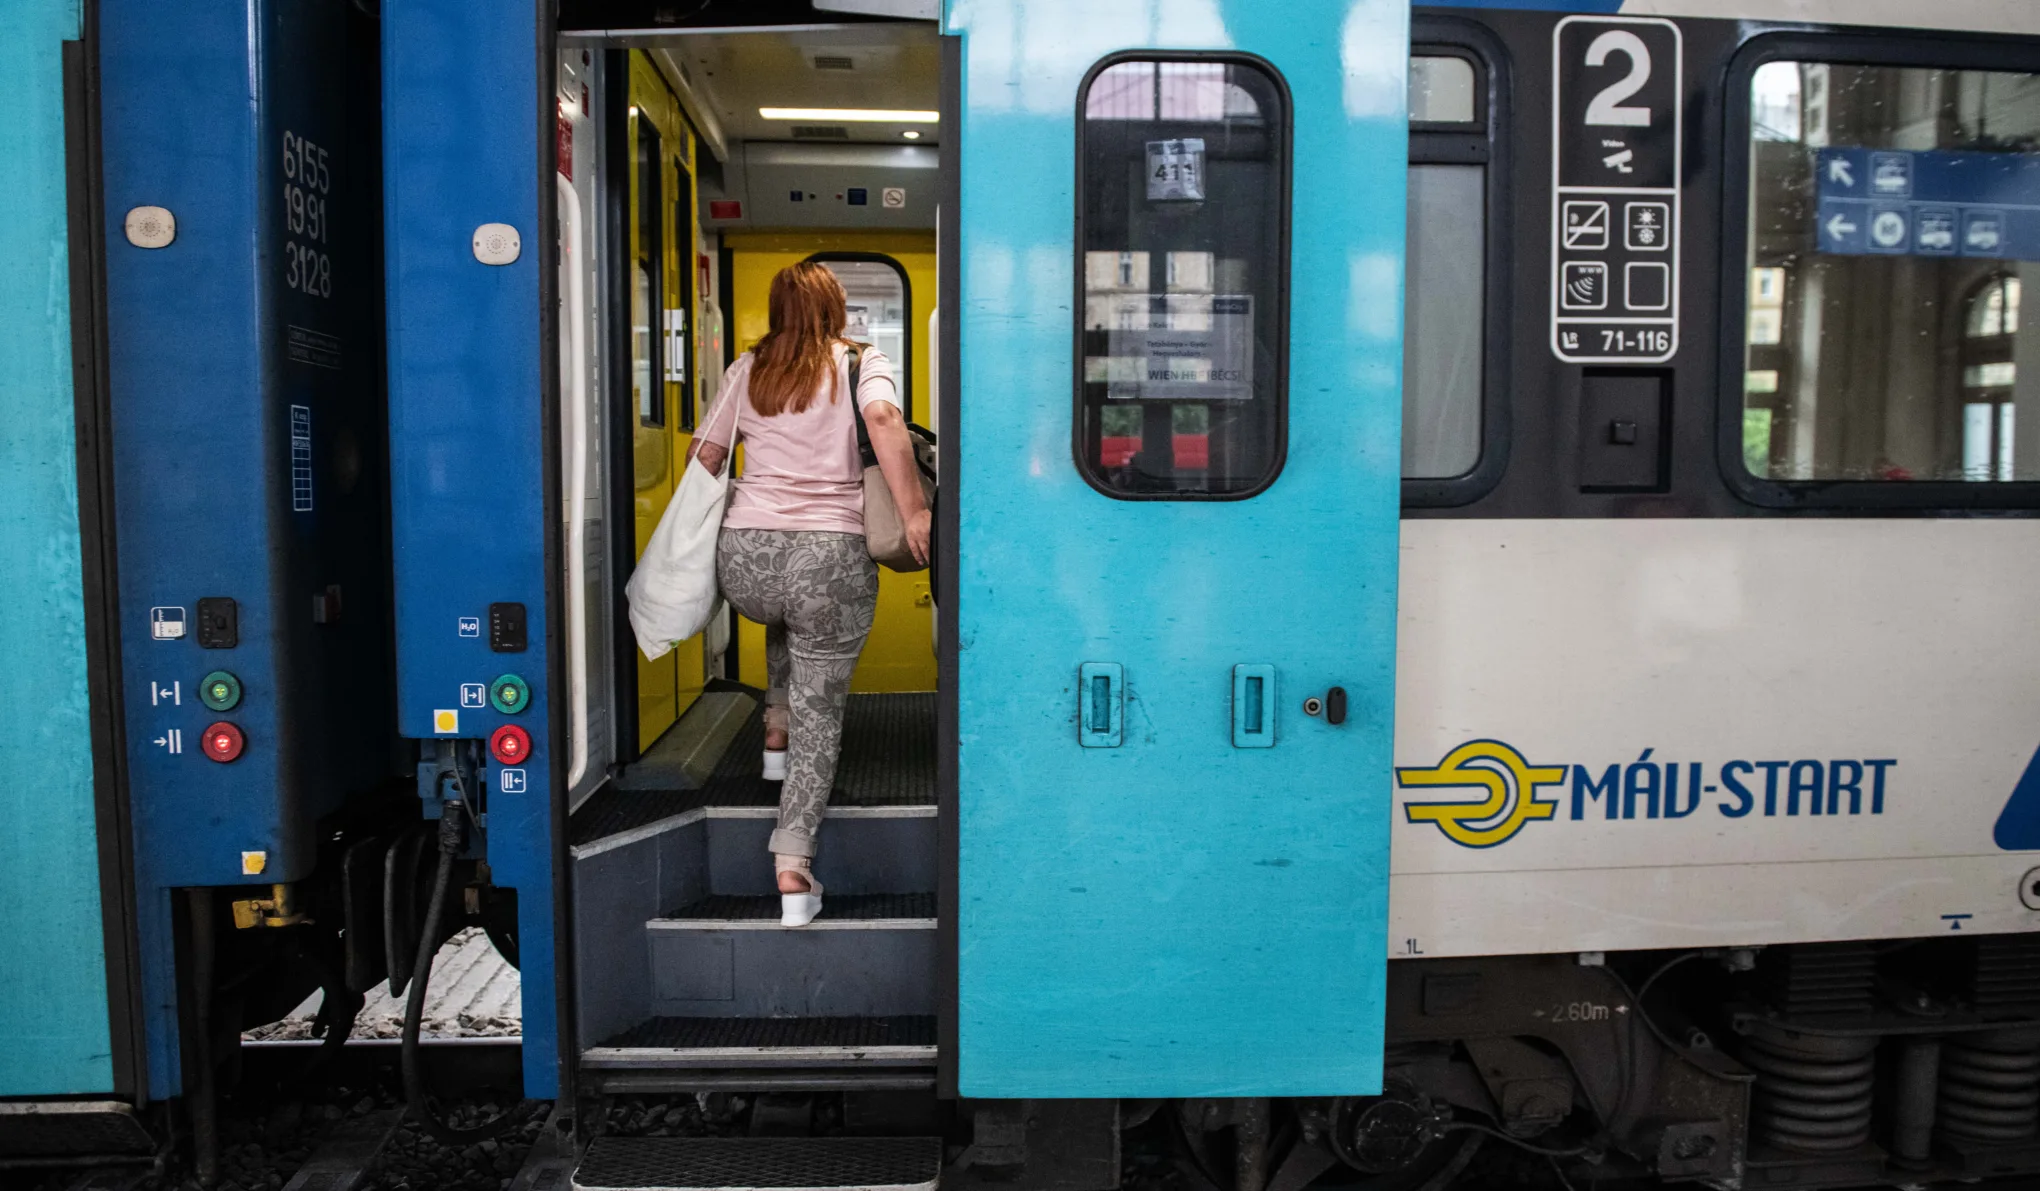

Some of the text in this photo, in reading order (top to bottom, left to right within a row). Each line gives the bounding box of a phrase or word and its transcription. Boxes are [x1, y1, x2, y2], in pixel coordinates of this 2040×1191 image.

[1584, 29, 1651, 127] 2
[1601, 330, 1669, 352] 71-116
[1148, 369, 1179, 381] WIEN
[1570, 747, 1898, 821] MÁV-START
[1552, 1001, 1609, 1023] 2.60m
